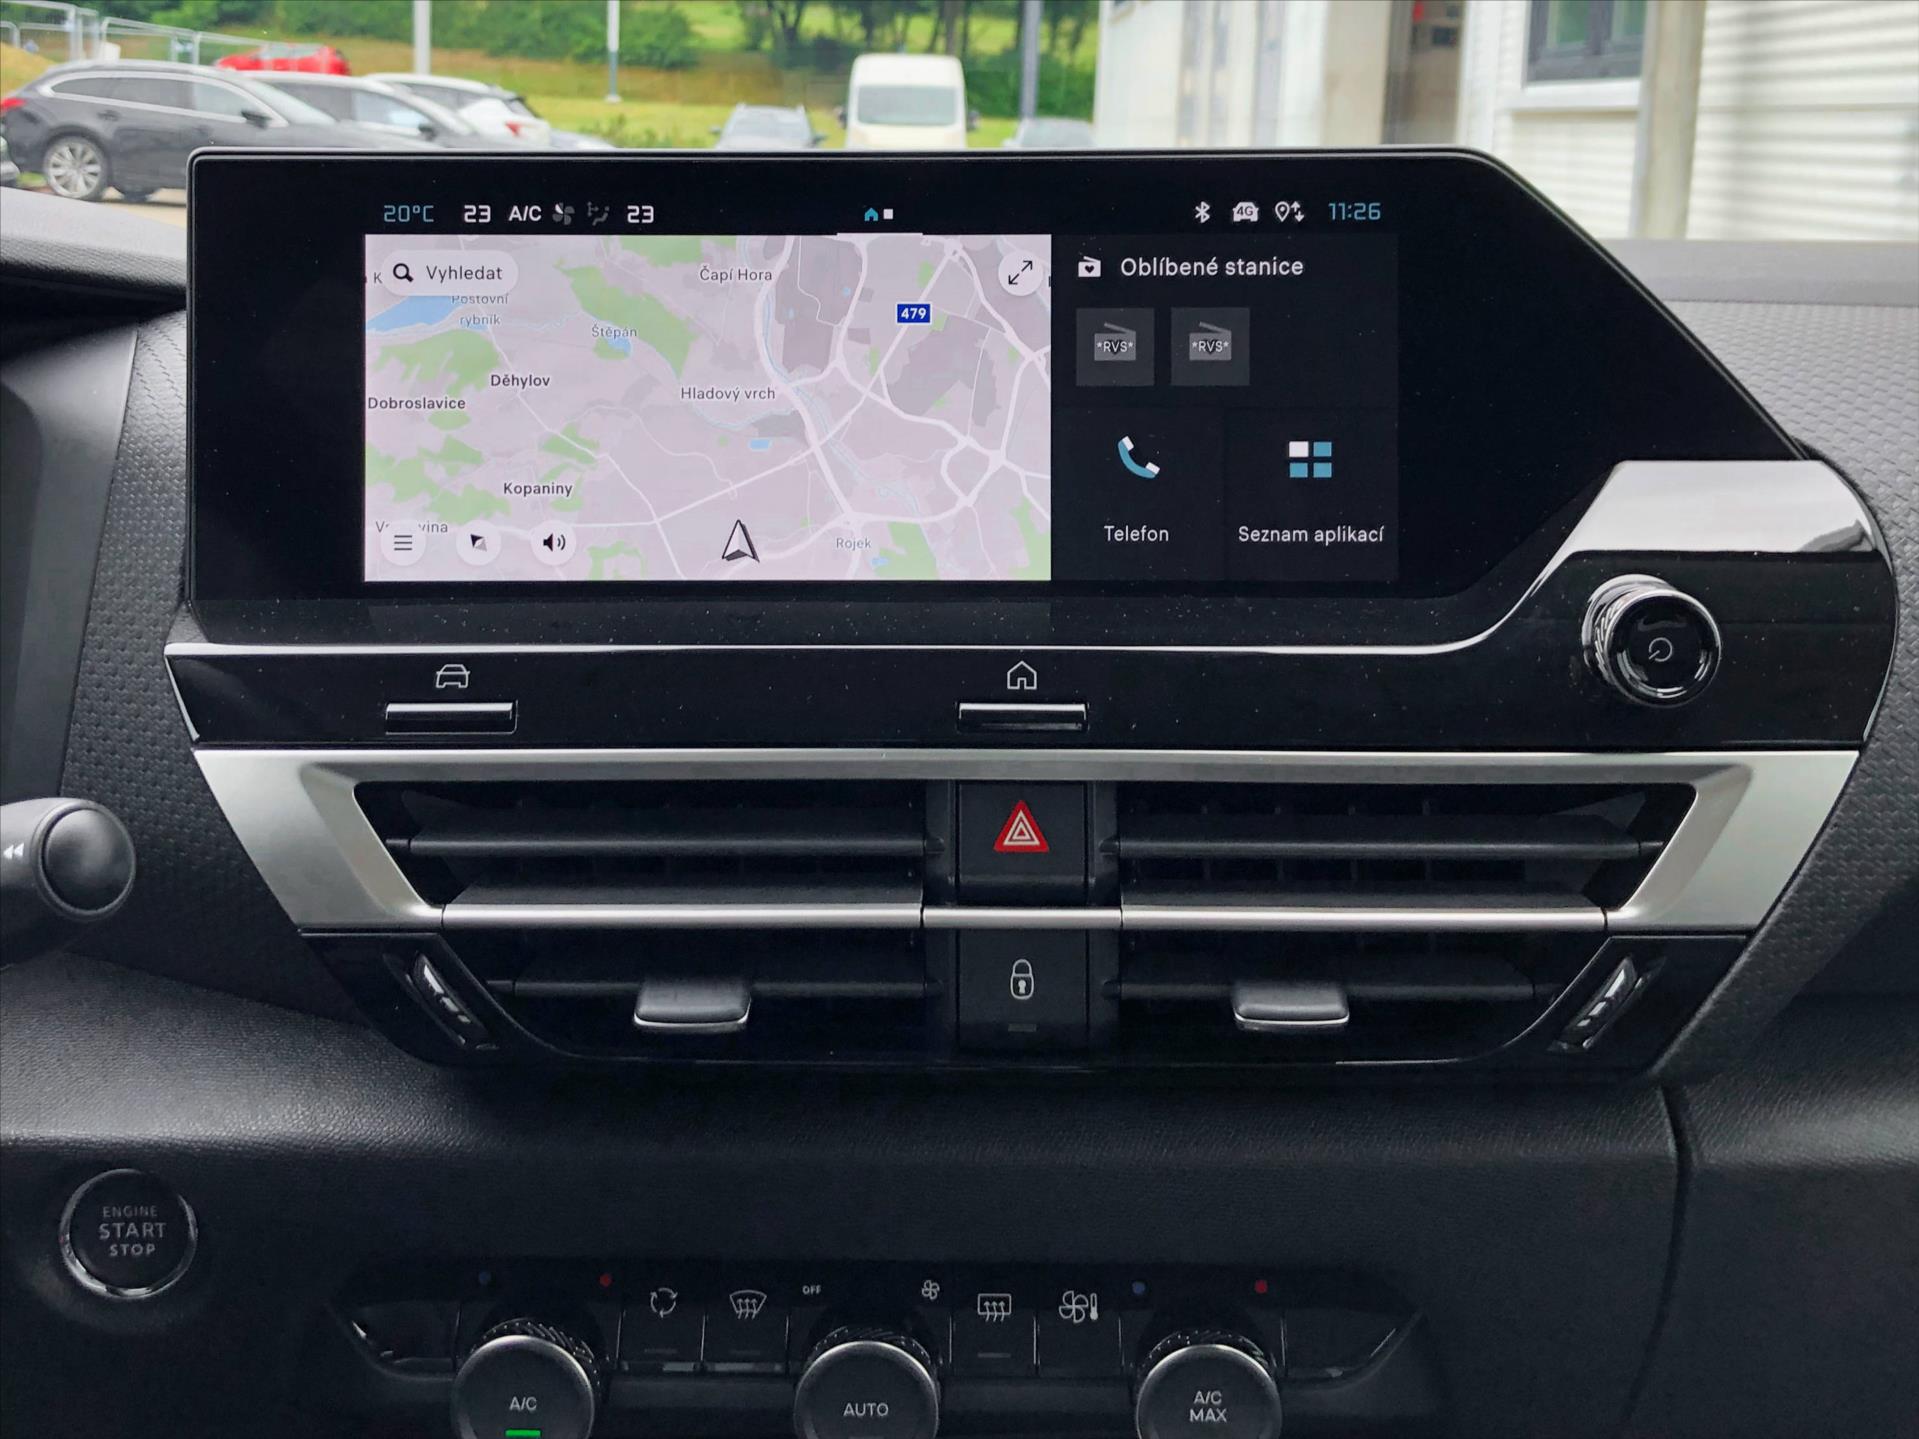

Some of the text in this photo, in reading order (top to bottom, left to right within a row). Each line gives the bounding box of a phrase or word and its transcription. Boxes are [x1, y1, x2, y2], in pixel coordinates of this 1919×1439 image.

[383, 204, 434, 222] 20°C
[463, 204, 491, 223] 23
[508, 205, 542, 222] A/C
[626, 205, 655, 223] 23
[1236, 205, 1254, 217] 4G
[1328, 202, 1381, 221] 11:26
[426, 264, 503, 283] Vyhledat
[699, 264, 773, 282] Čapí Hora
[1120, 257, 1304, 276] Oblíbené stanice
[901, 307, 927, 320] 479
[591, 324, 638, 340] Štěpán
[490, 374, 551, 391] Děhylov
[681, 386, 776, 403] Hladový vrch
[367, 397, 466, 410] Dobroslavice
[503, 482, 573, 499] Kopaniny
[1104, 526, 1170, 542] Telefon
[1238, 525, 1385, 547] Seznam aplikací
[836, 537, 872, 552] Rojek
[102, 1205, 158, 1218] ENGINE
[99, 1222, 167, 1240] START
[109, 1244, 156, 1257] STOP
[802, 1285, 821, 1296] OFF
[508, 1396, 537, 1412] A/C
[1193, 1390, 1222, 1405] A/C
[843, 1402, 889, 1418] AUTO
[1189, 1407, 1227, 1422] MAX
